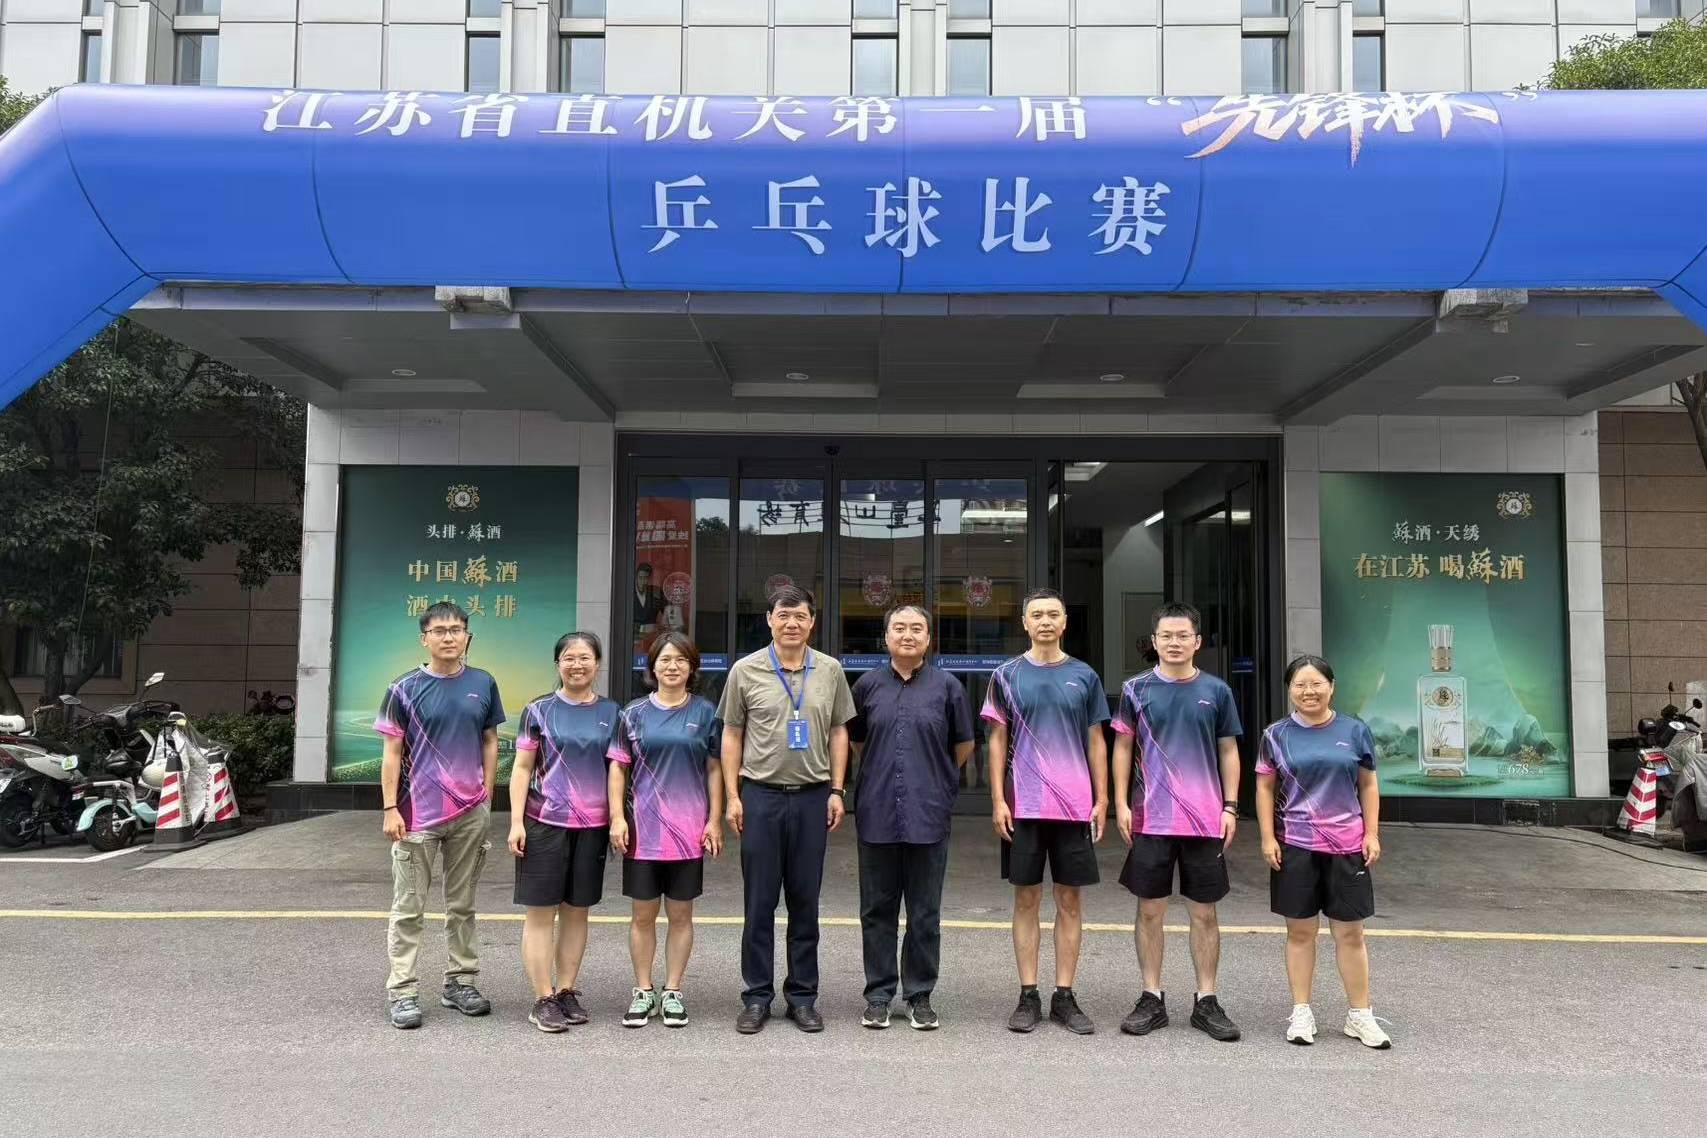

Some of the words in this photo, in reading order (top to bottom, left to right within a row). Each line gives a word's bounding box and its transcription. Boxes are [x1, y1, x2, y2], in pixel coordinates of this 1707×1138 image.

[641, 174, 1171, 258] 乒乓球比赛
[1352, 552, 1430, 579] 在江苏
[407, 595, 517, 617] 酒头排
